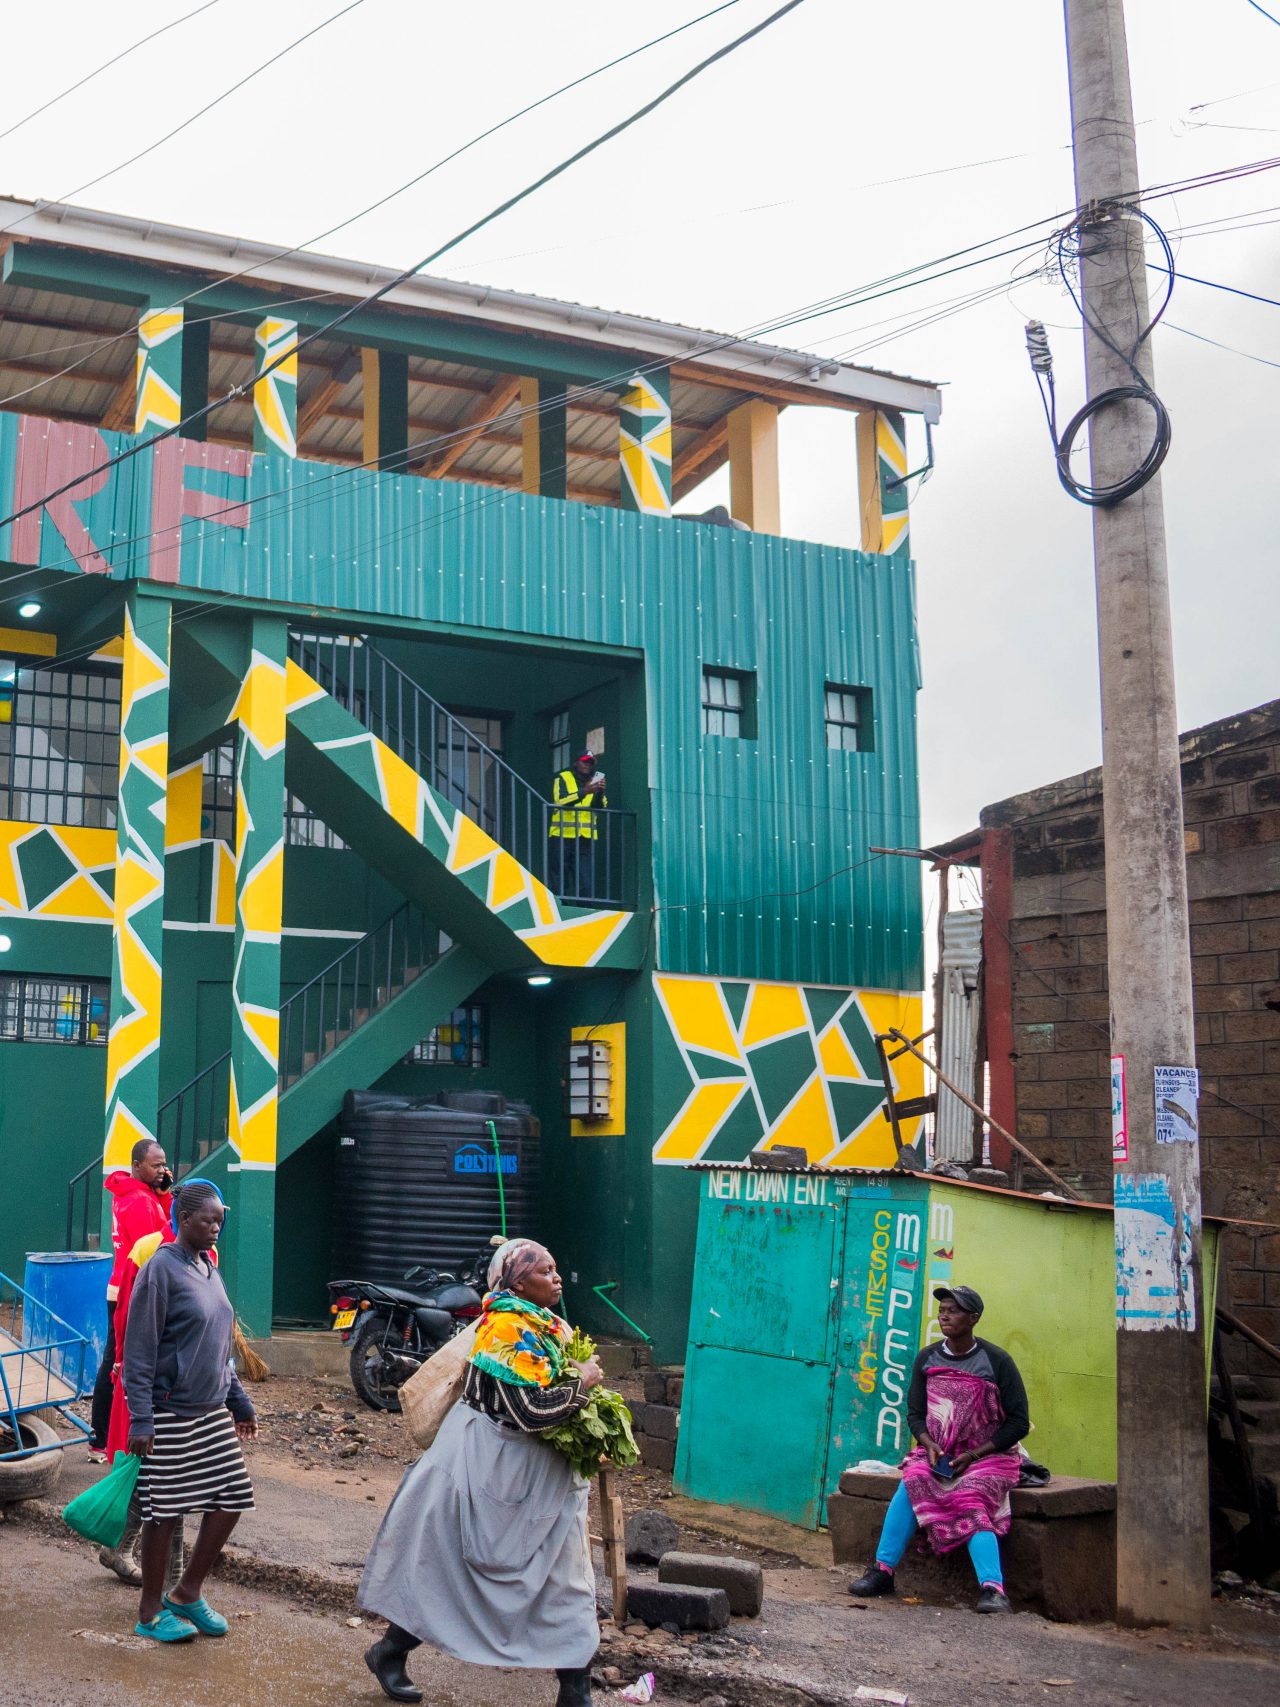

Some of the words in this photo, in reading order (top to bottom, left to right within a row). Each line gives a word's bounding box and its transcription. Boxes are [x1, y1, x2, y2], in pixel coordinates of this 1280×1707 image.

[708, 1169, 741, 1200] NEW
[745, 1171, 789, 1203] DAWN
[858, 1210, 892, 1393] COSMETICS
